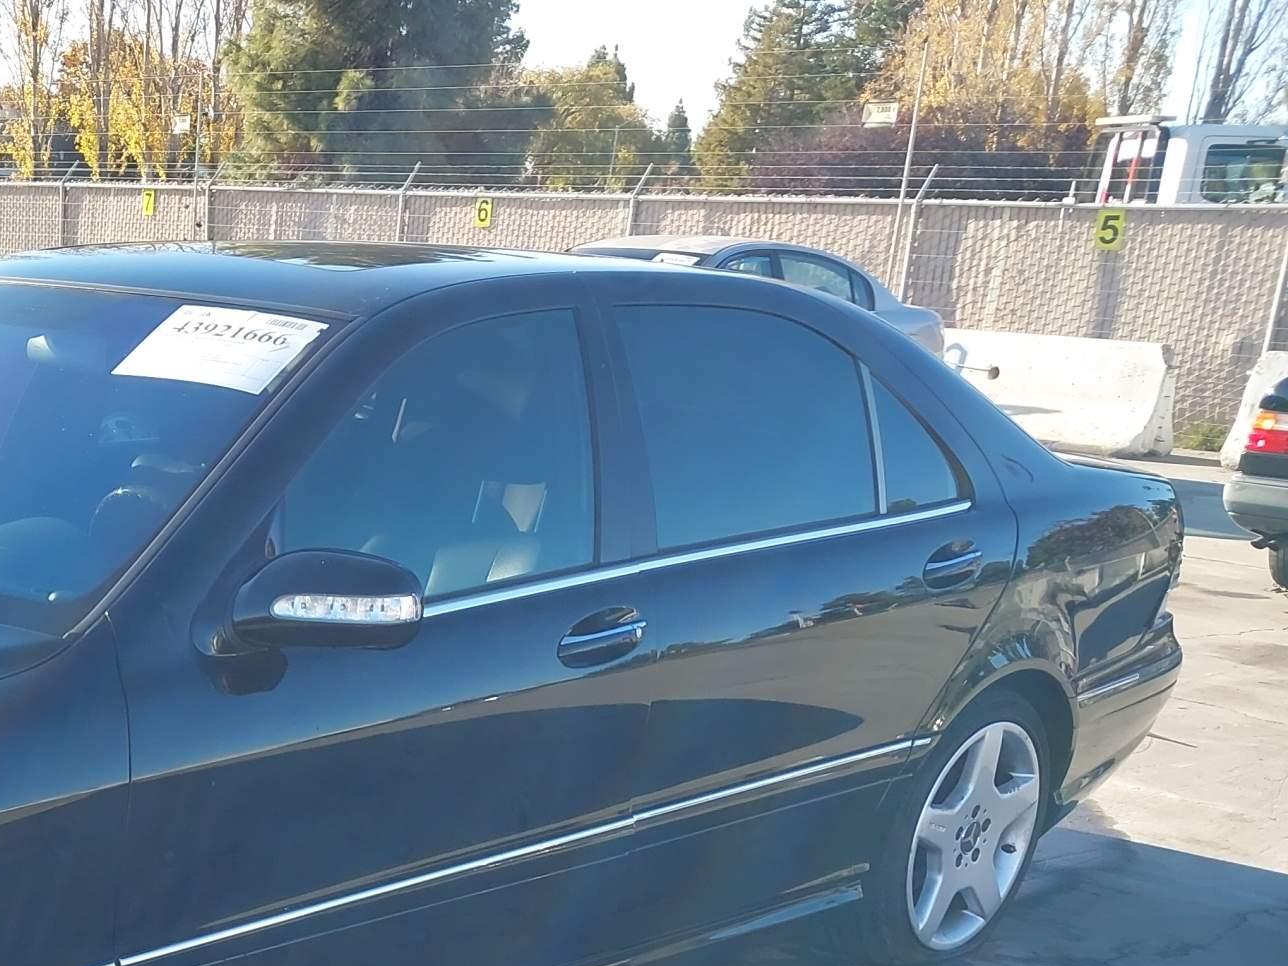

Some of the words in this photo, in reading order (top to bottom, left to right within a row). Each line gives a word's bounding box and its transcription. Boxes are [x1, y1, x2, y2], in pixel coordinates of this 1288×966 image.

[145, 192, 153, 211] 7
[478, 199, 489, 222] 6
[1099, 214, 1121, 245] 5
[172, 320, 290, 347] 43921666
